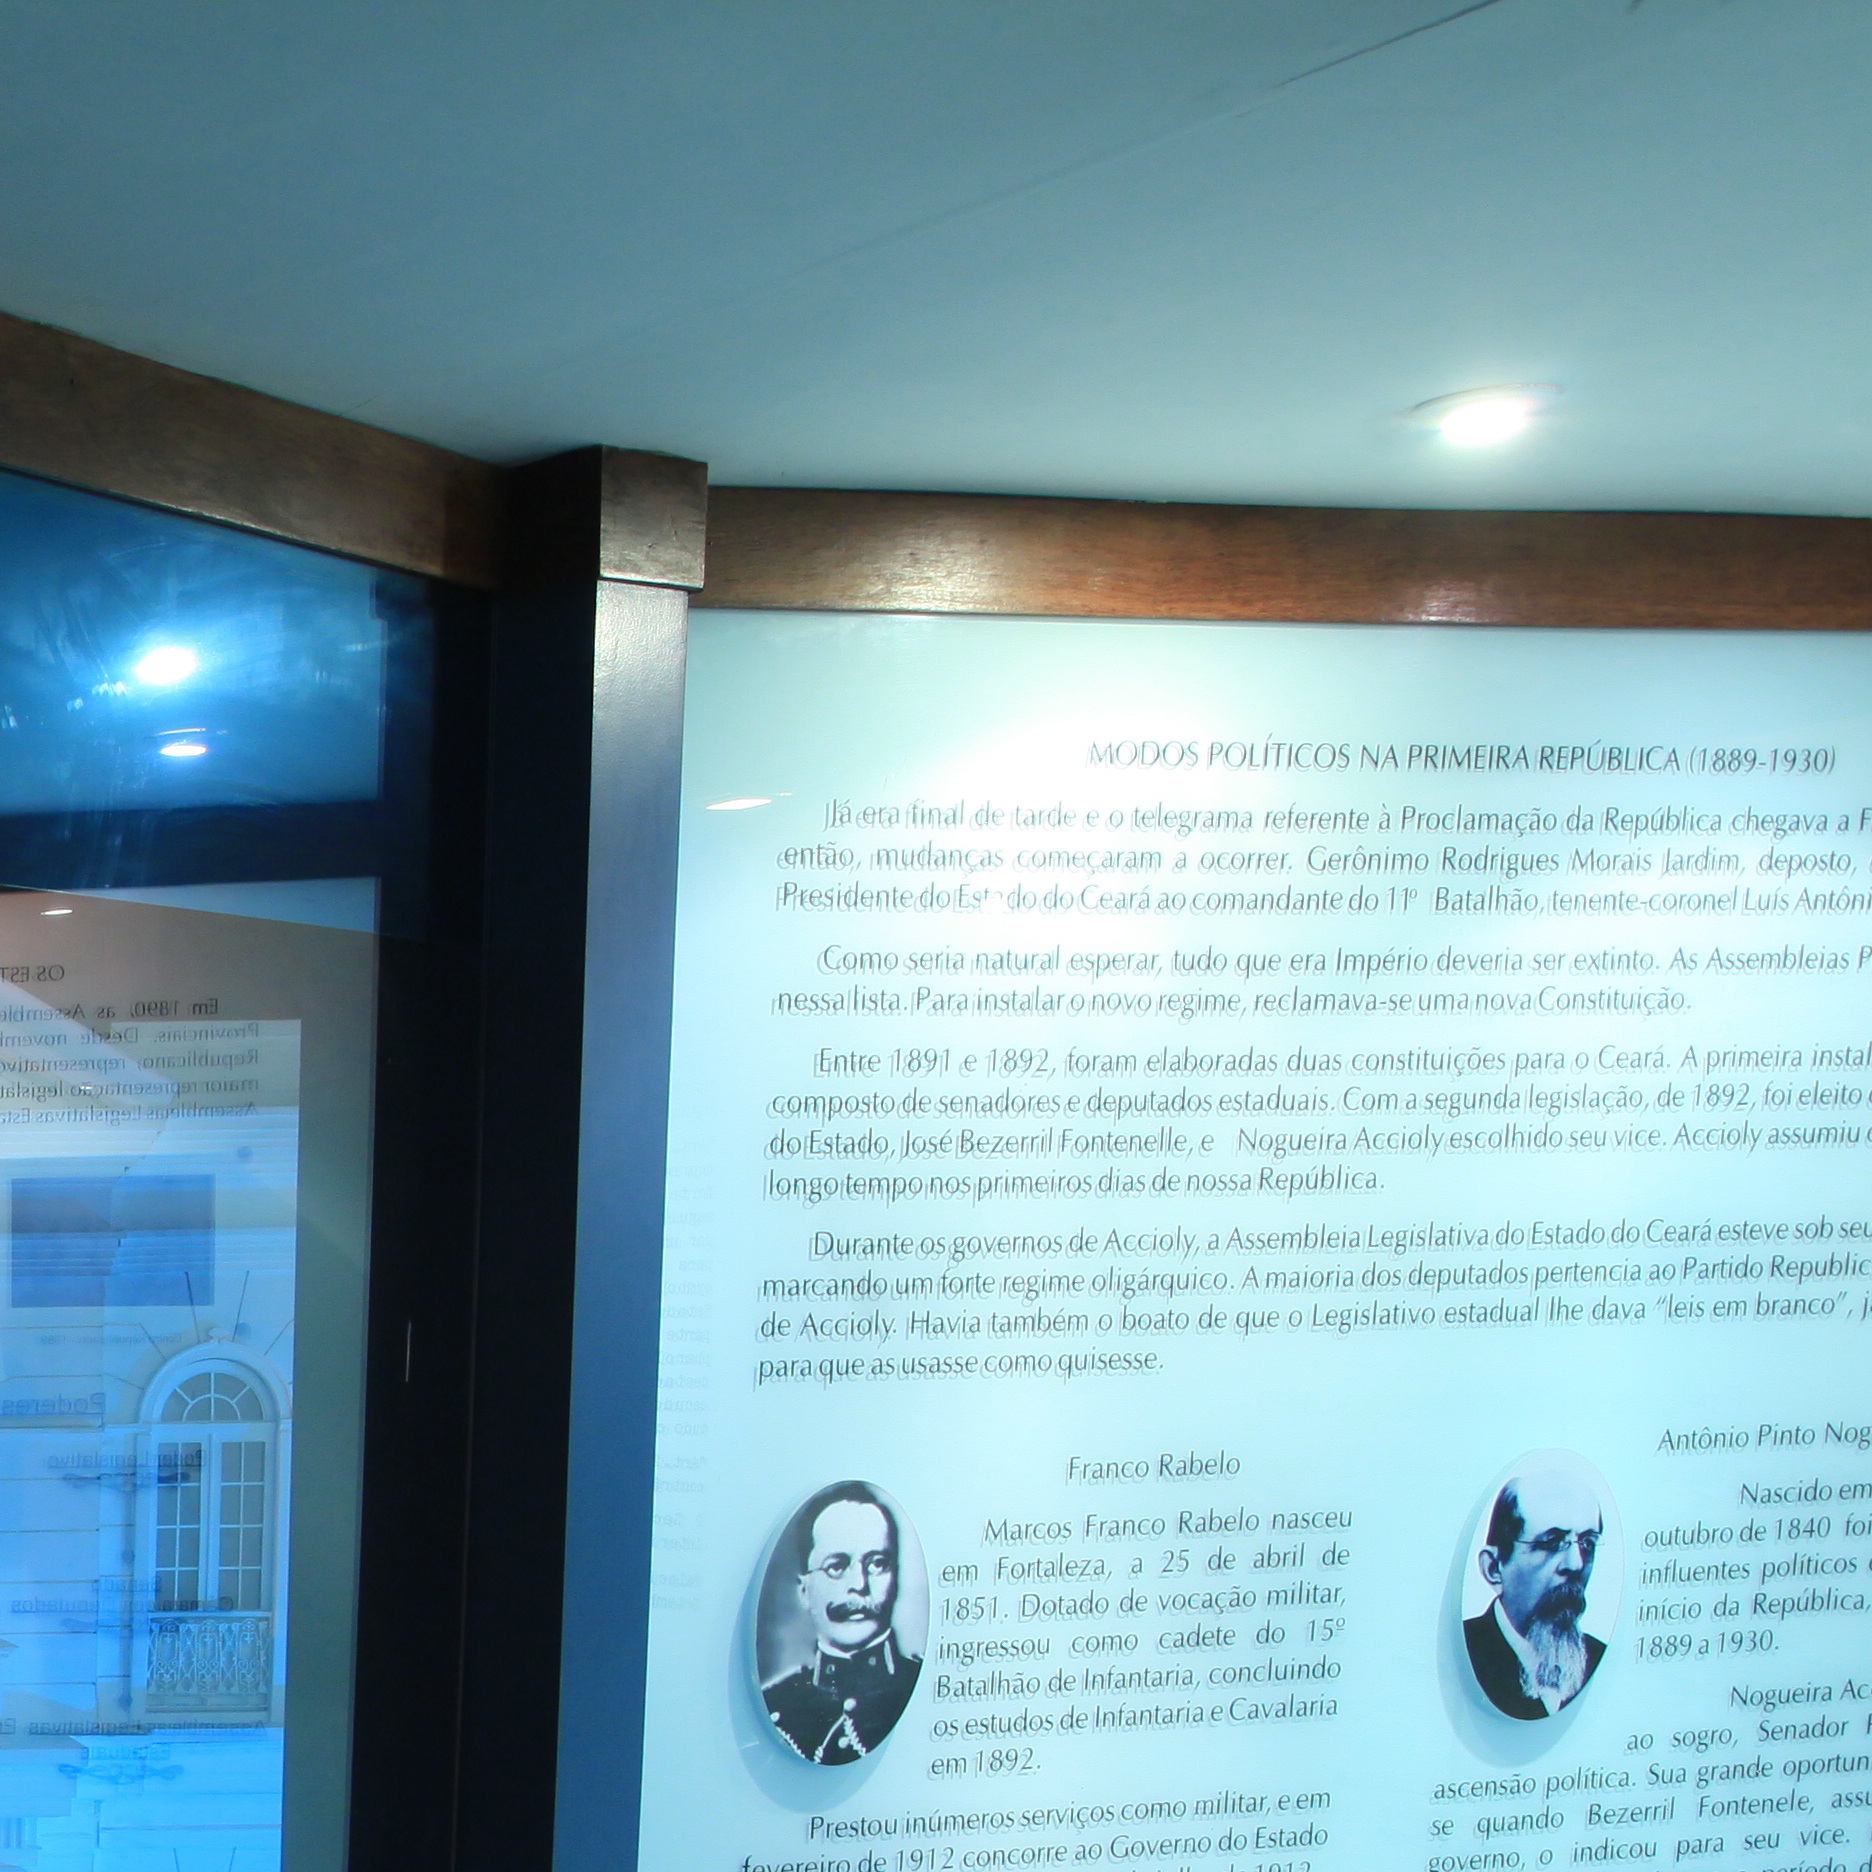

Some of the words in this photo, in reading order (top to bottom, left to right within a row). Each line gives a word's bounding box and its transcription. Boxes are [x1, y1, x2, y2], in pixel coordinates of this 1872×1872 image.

[1089, 740, 1199, 767] MODOS
[1209, 732, 1351, 769] POLÍTICOS
[1360, 743, 1400, 769] NA
[1407, 744, 1530, 770] PRIMEIRA
[1538, 739, 1681, 772] REPÚBLICA
[1689, 745, 1836, 775] (1889-1930)
[819, 1048, 881, 1073] Entre
[894, 1048, 950, 1072] 1891
[964, 1055, 977, 1072] e
[989, 1048, 1056, 1075] 1892,
[1068, 1046, 1136, 1072] foram
[1147, 1046, 1278, 1072] elaboradas
[1287, 1046, 1342, 1070] duas
[1352, 1045, 1506, 1077] constituições
[1515, 1052, 1565, 1078] para
[1575, 1052, 1589, 1069] o
[1598, 1044, 1671, 1069] Ceará.
[1681, 1045, 1698, 1068] A
[1706, 1044, 1803, 1075] primeira
[759, 1357, 812, 1386] para
[819, 1357, 865, 1384] que
[871, 1357, 895, 1376] as
[902, 1354, 979, 1374] usasse
[984, 1353, 1052, 1373] como
[1058, 1347, 1164, 1380] quisesse.
[1657, 1425, 1749, 1452] Antônio
[1757, 1423, 1815, 1447] Pinto
[1068, 1456, 1149, 1480] Franco
[1158, 1450, 1241, 1477] Rabelo
[941, 1597, 1009, 1621] 1851.
[1022, 1589, 1108, 1618] Dotado
[1119, 1588, 1148, 1612] de
[1159, 1585, 1256, 1615] vocação
[1266, 1580, 1346, 1607] militar,
[1637, 1634, 1692, 1658] 1889
[1698, 1638, 1709, 1654] a
[1718, 1629, 1779, 1653] 1930.
[931, 1757, 967, 1775] em
[977, 1747, 1041, 1773] 1892.
